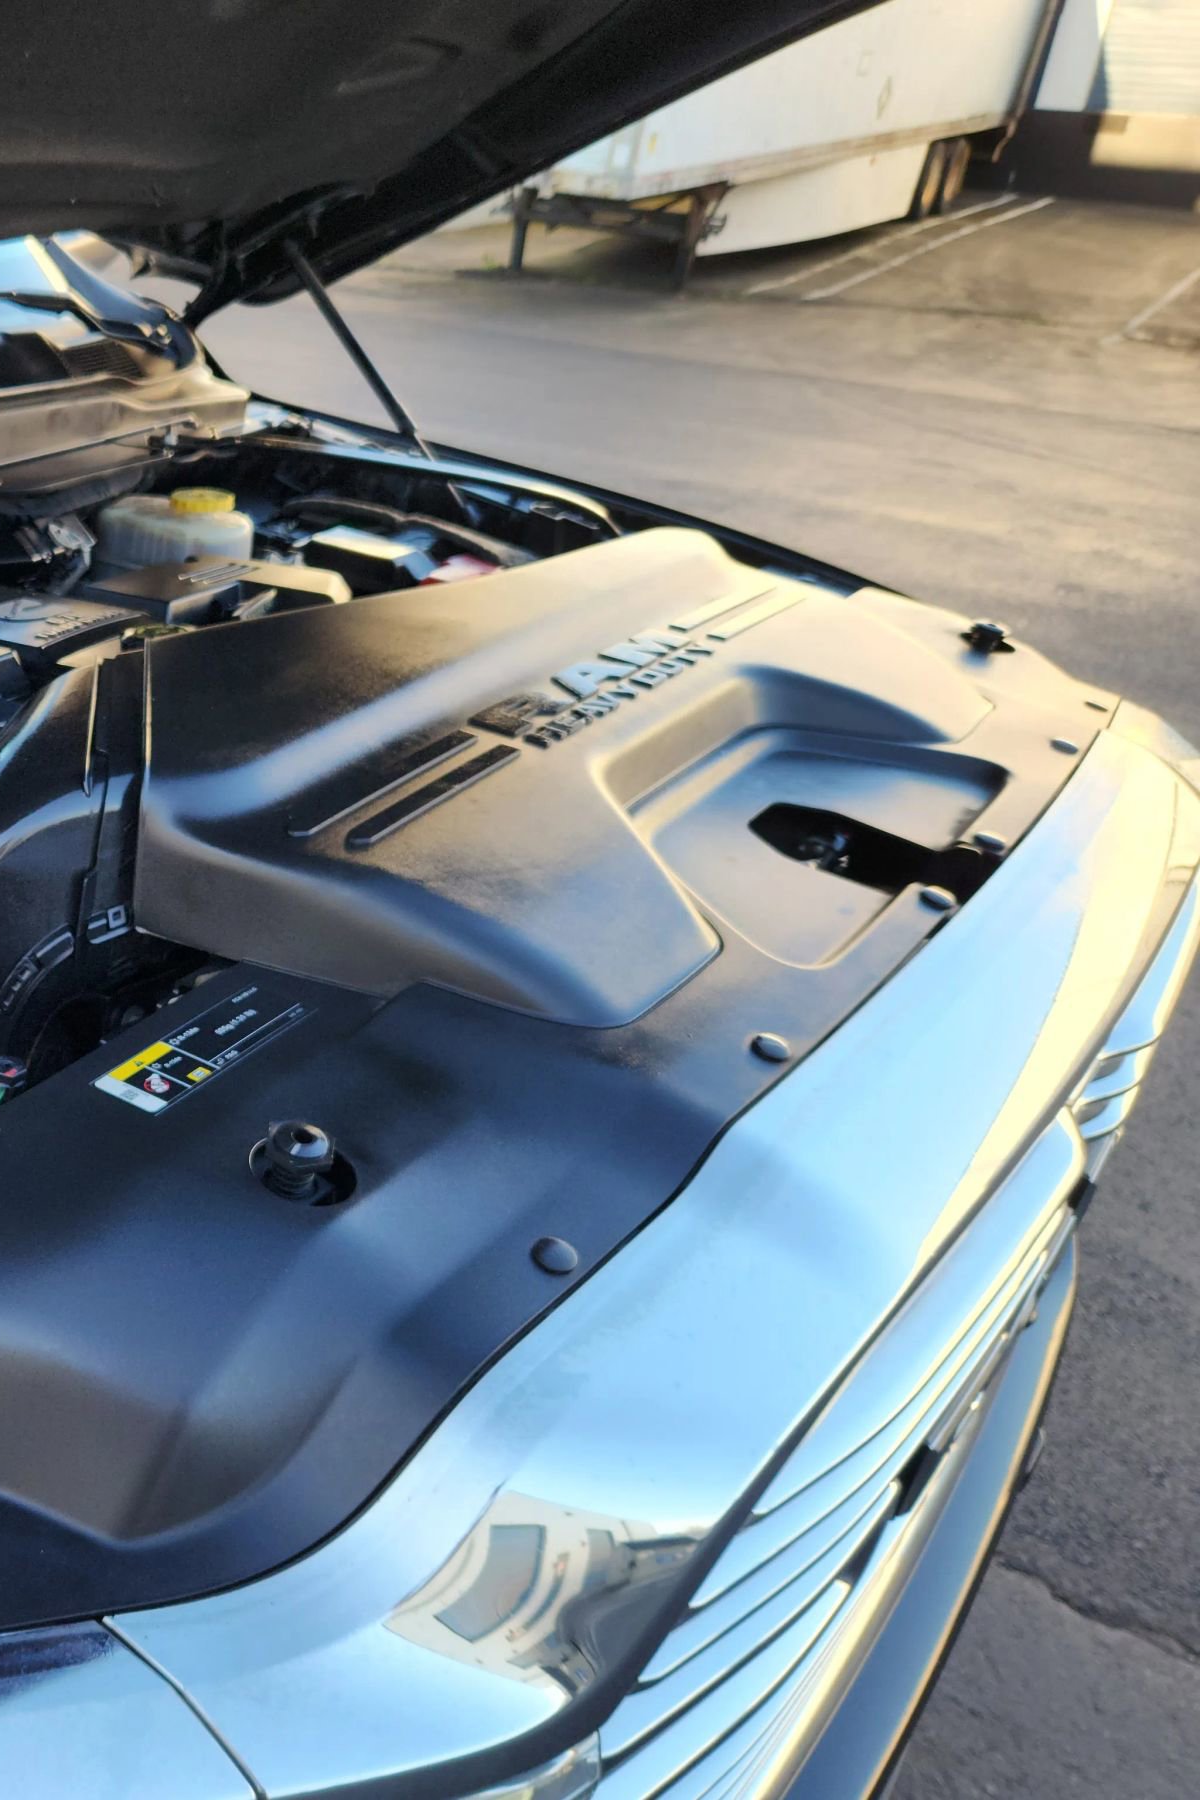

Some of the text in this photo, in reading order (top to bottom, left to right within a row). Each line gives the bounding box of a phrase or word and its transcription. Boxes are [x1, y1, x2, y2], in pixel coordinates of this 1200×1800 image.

[468, 630, 691, 737] RAM
[523, 643, 714, 749] HEAVY DUTY
